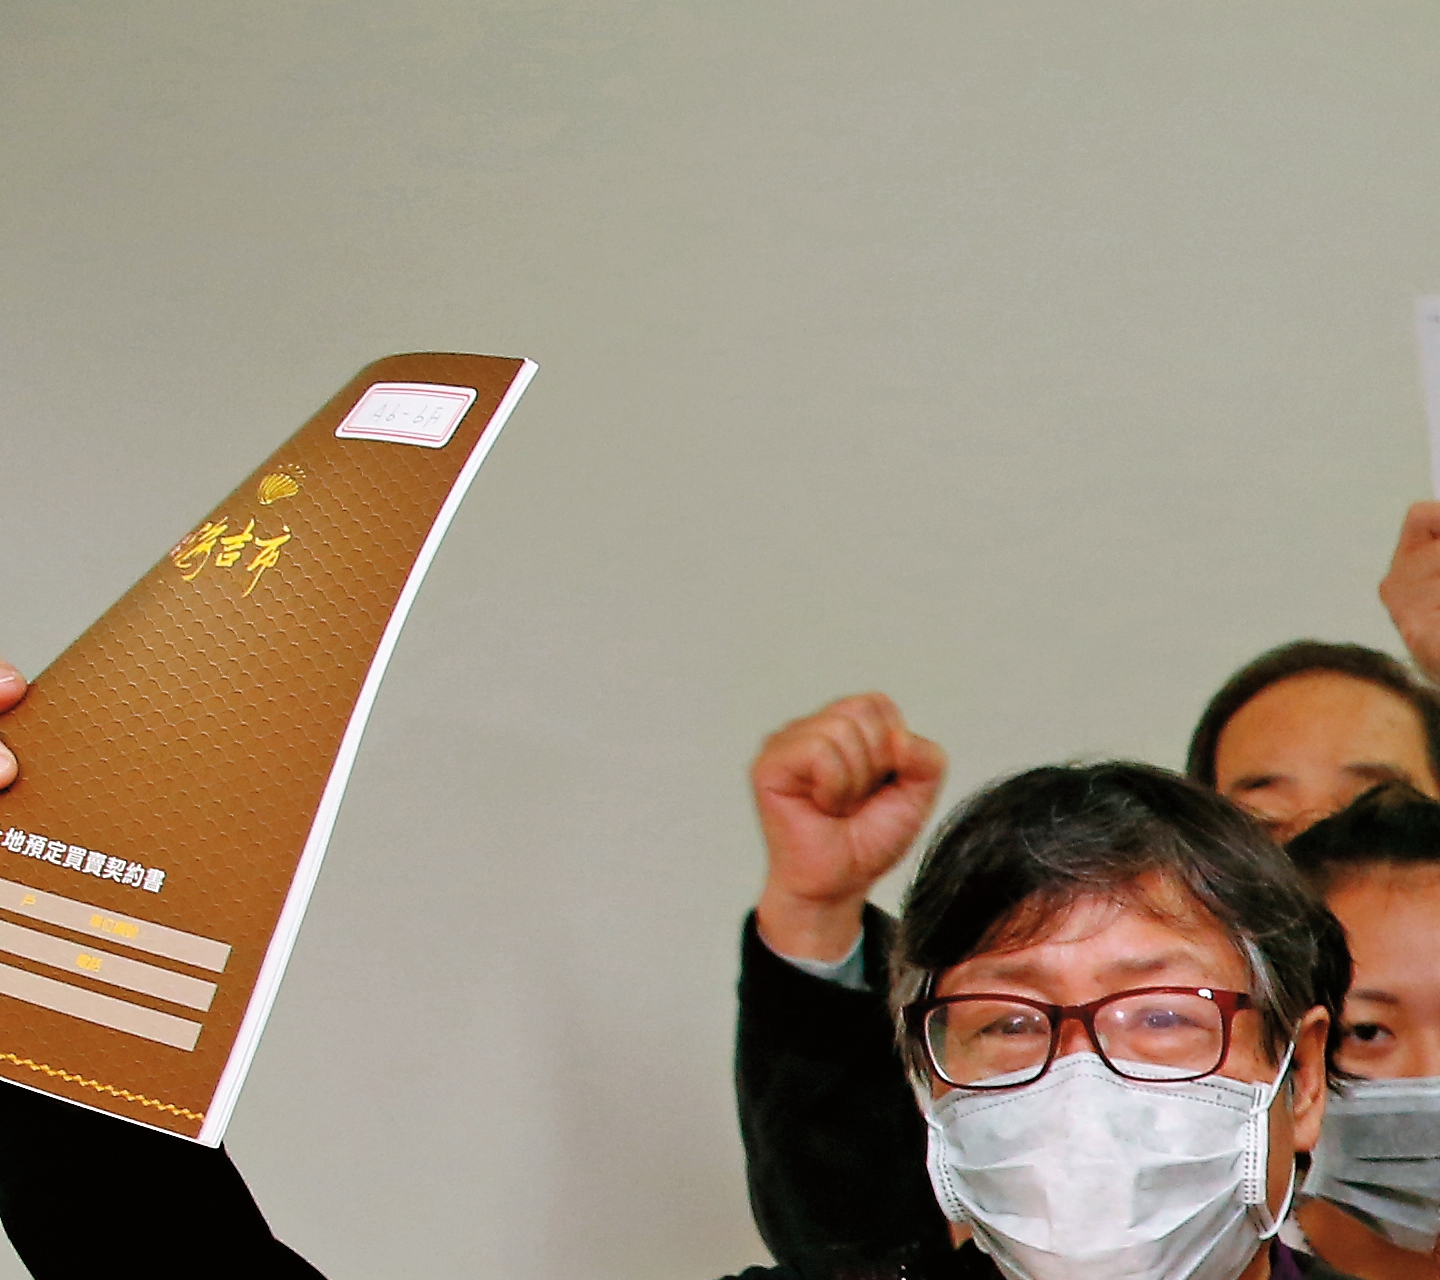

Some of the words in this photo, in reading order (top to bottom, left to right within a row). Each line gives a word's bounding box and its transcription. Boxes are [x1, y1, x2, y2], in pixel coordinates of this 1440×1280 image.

[0, 827, 167, 894] 地預定買賣契約書
